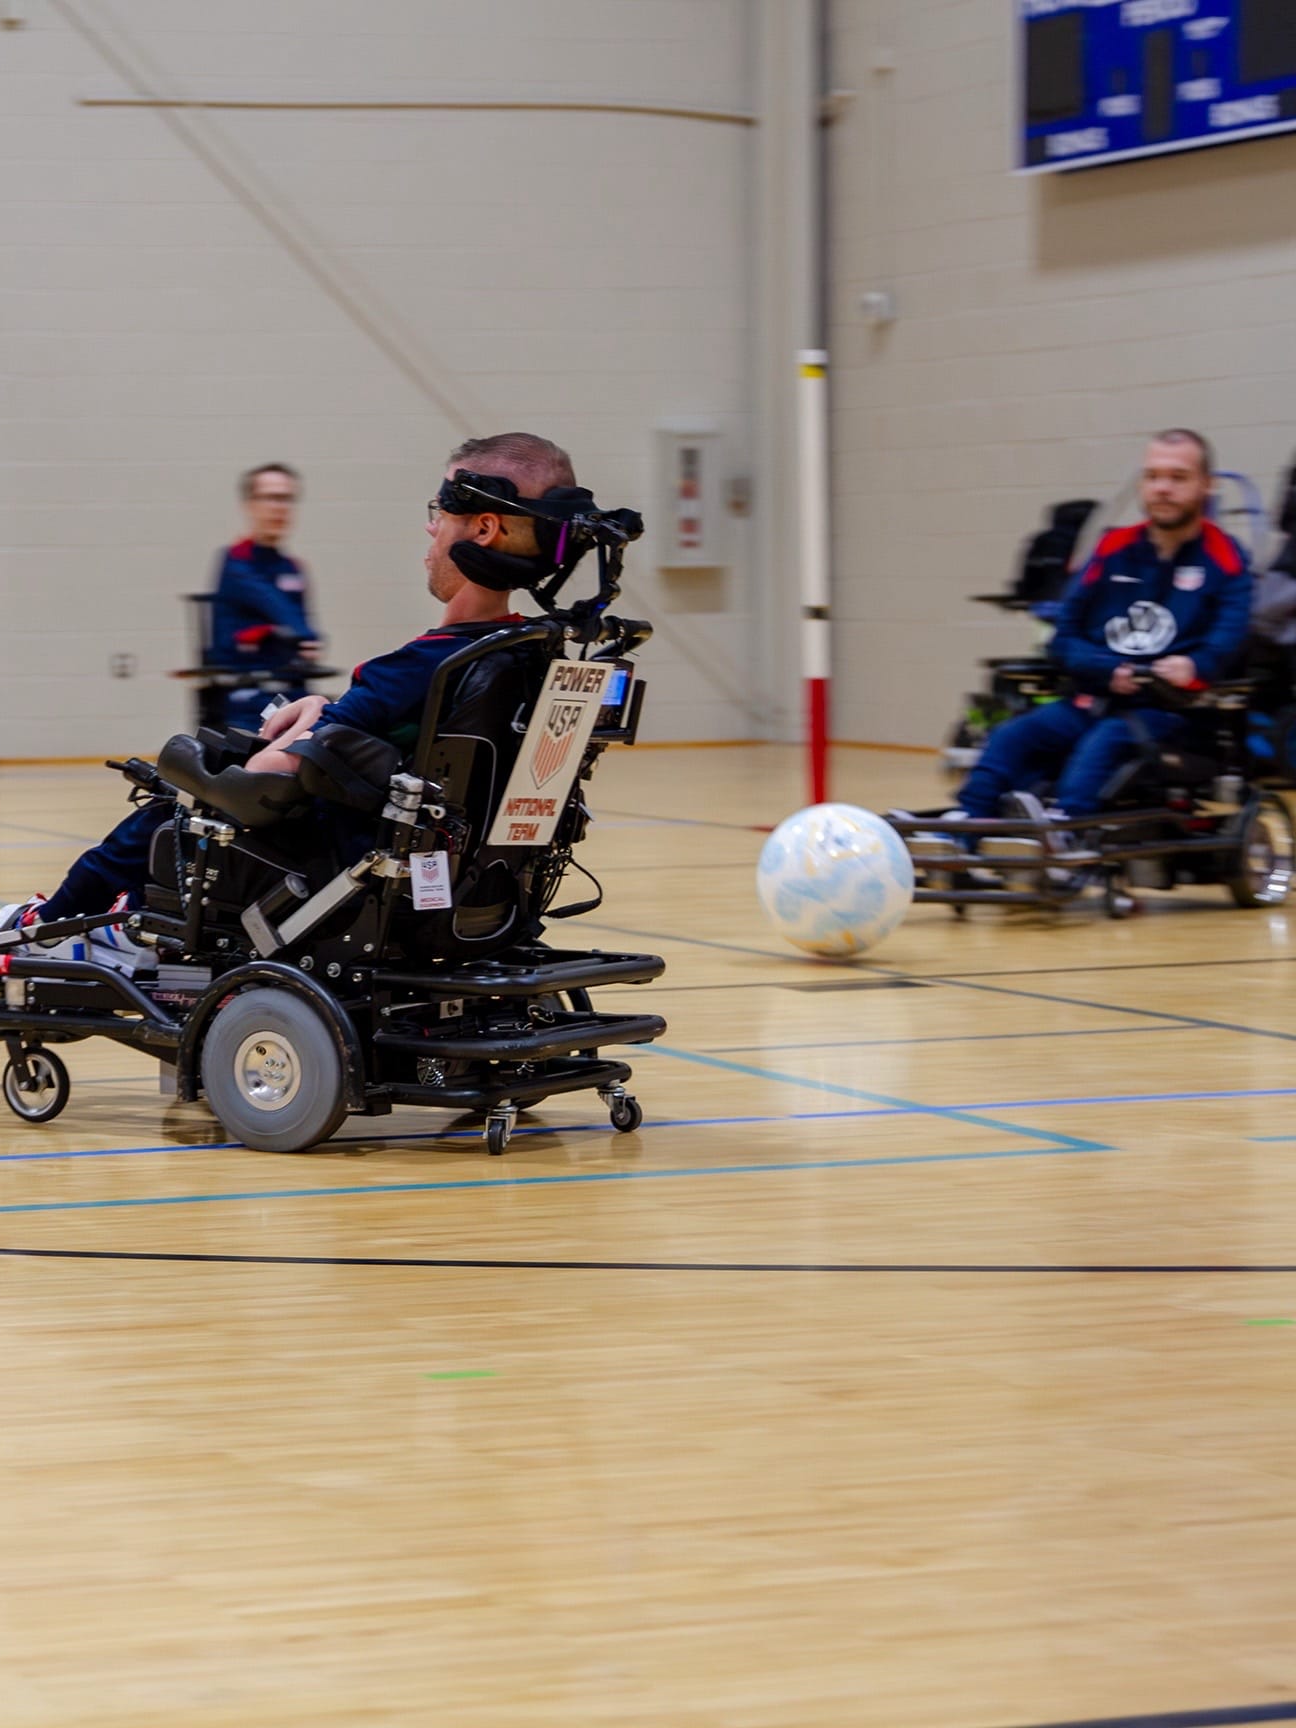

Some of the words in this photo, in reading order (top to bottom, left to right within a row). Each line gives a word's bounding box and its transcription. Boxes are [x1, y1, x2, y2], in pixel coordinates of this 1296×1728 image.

[549, 666, 606, 693] POWER
[548, 704, 582, 738] USA
[502, 797, 557, 816] NATIONAL
[507, 823, 540, 841] TEAM
